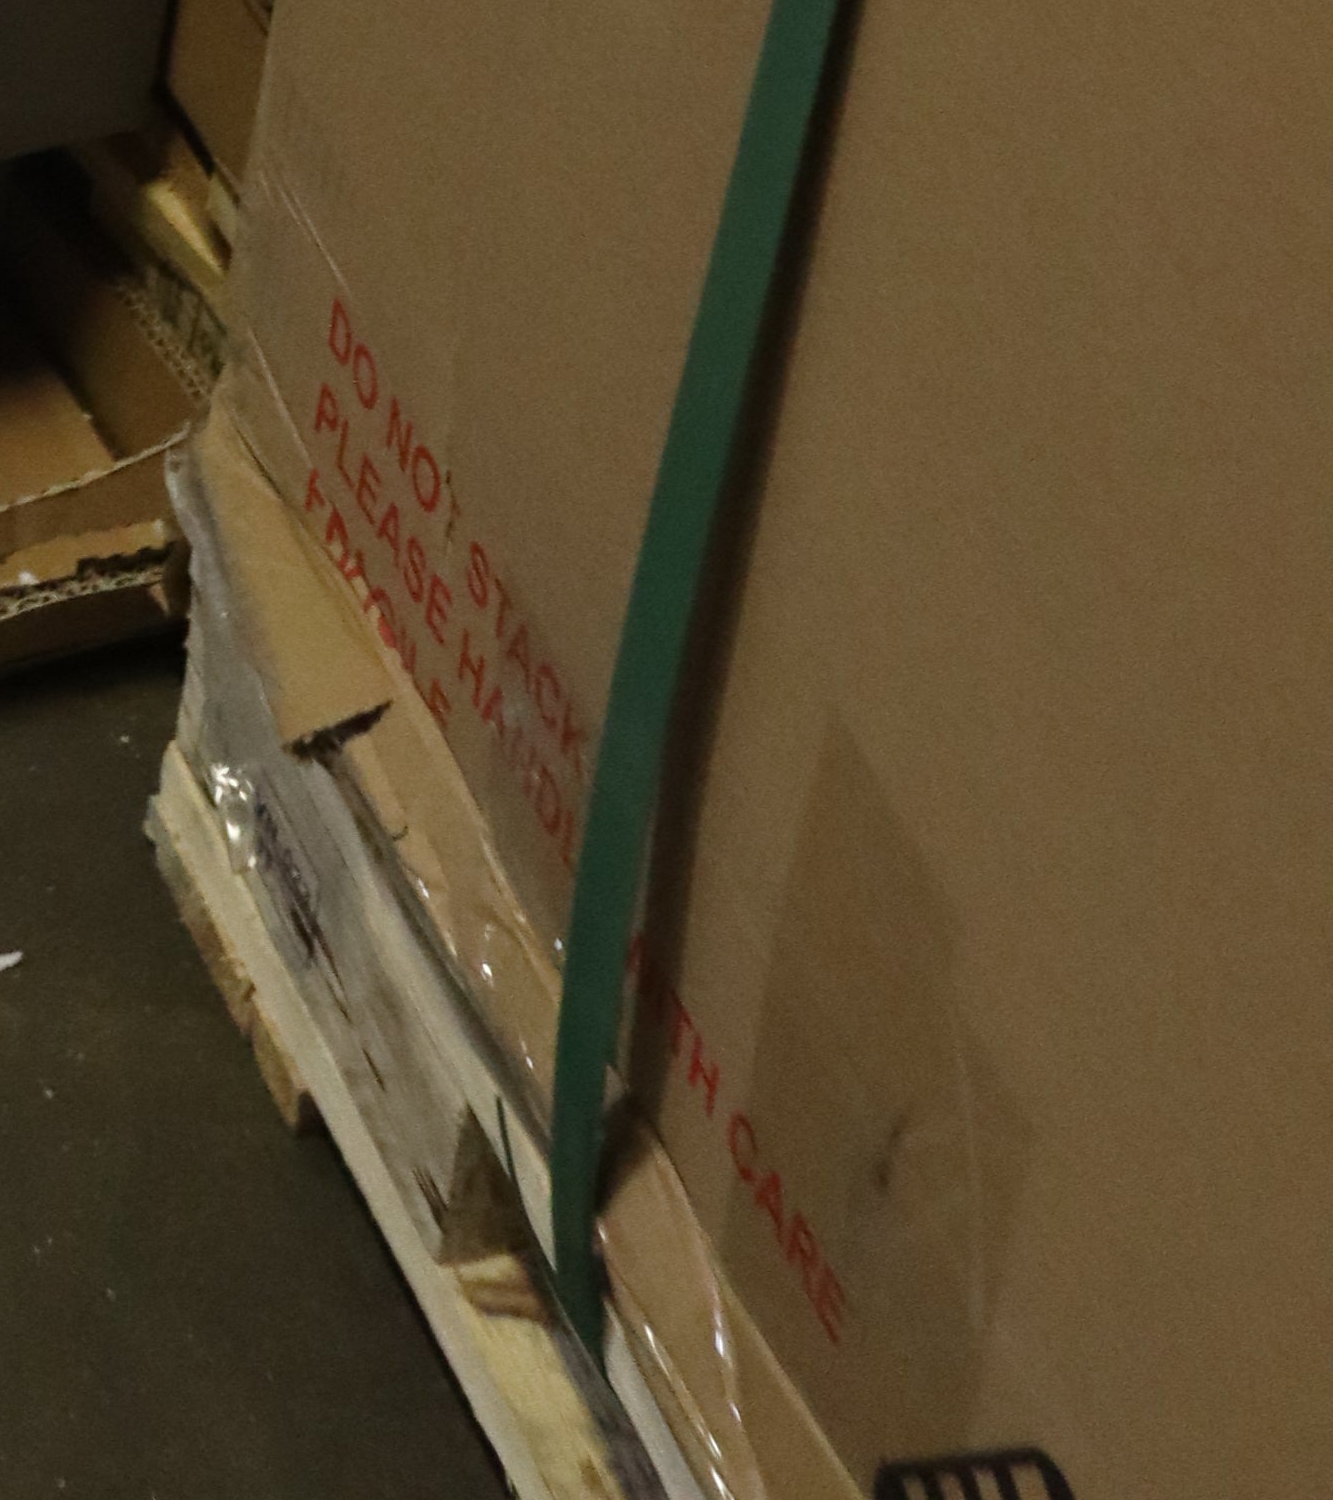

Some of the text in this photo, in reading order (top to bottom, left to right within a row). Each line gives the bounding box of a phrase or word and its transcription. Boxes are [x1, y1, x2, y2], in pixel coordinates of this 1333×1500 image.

[313, 381, 453, 646] PLEASE
[727, 1110, 846, 1346] CARE
[327, 296, 380, 411] DO
[468, 540, 585, 790] STACK
